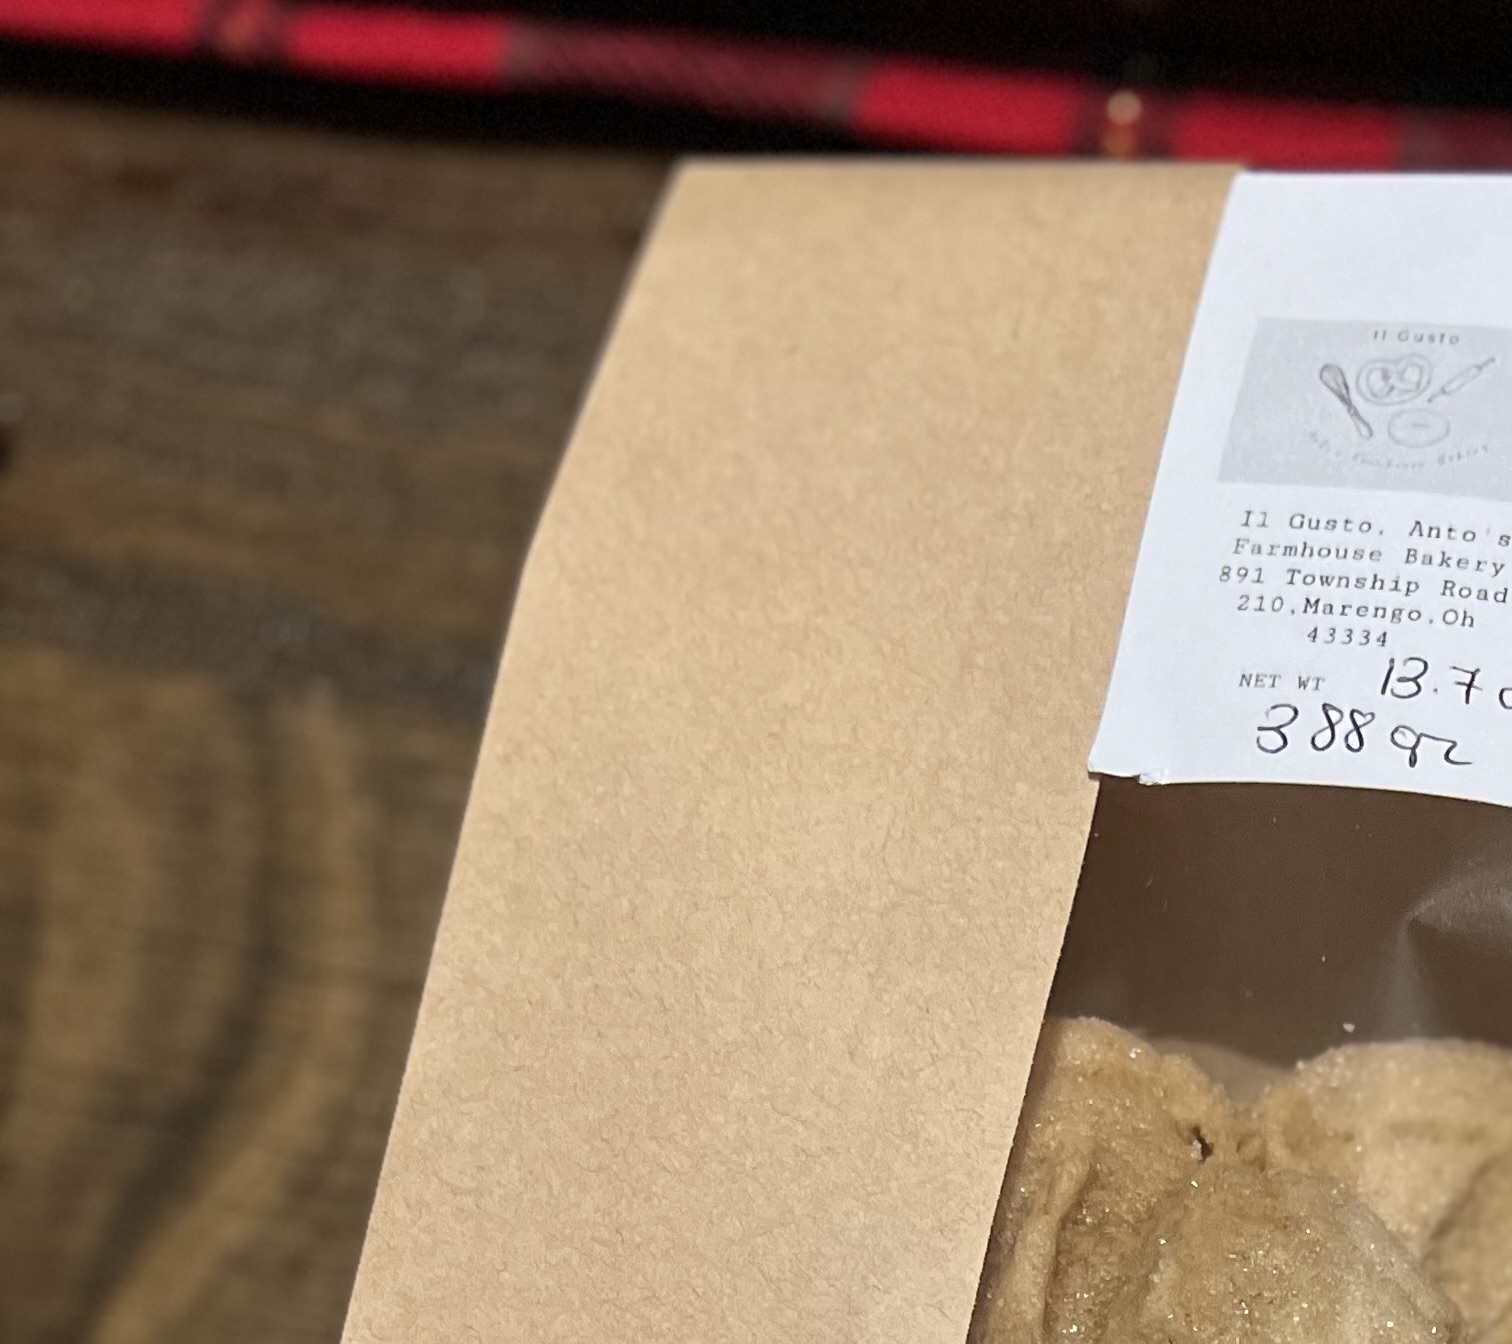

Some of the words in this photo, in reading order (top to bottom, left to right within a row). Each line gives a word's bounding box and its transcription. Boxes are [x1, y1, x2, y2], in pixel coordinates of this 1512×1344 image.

[1398, 329, 1460, 344] Gusto
[1240, 510, 1270, 529] Il
[1409, 520, 1511, 548] Anto's
[1233, 538, 1383, 563] Farmhouse
[1405, 549, 1506, 577] Bakery
[1218, 566, 1265, 585] 891
[1286, 569, 1420, 595] Township
[1441, 581, 1509, 604] Road
[1307, 627, 1388, 647] 43334
[1239, 673, 1279, 689] NET
[1298, 676, 1326, 692] WT
[1380, 656, 1483, 705] 13.7
[1256, 702, 1375, 754] 388
